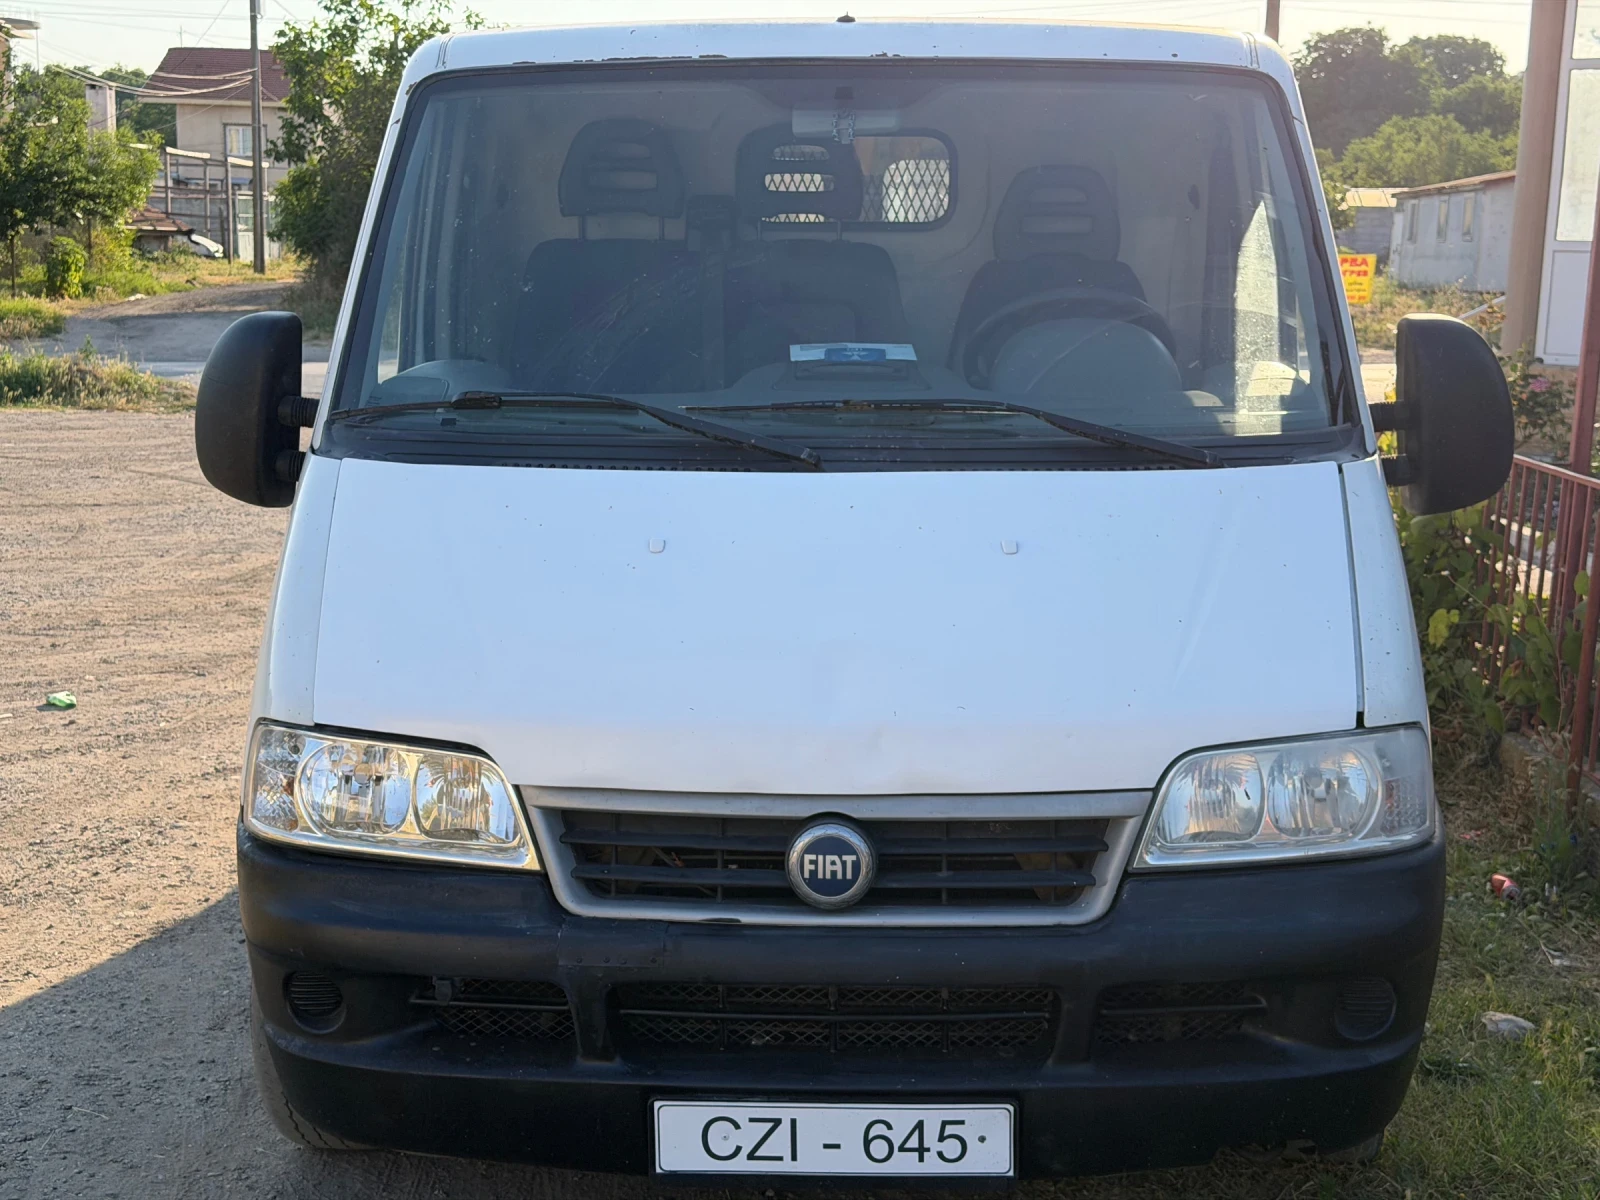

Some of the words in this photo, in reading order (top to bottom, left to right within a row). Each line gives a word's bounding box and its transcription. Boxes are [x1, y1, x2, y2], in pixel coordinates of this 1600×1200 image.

[803, 854, 857, 880] FIAT
[701, 1116, 798, 1162] CZI
[862, 1119, 968, 1163] 645
